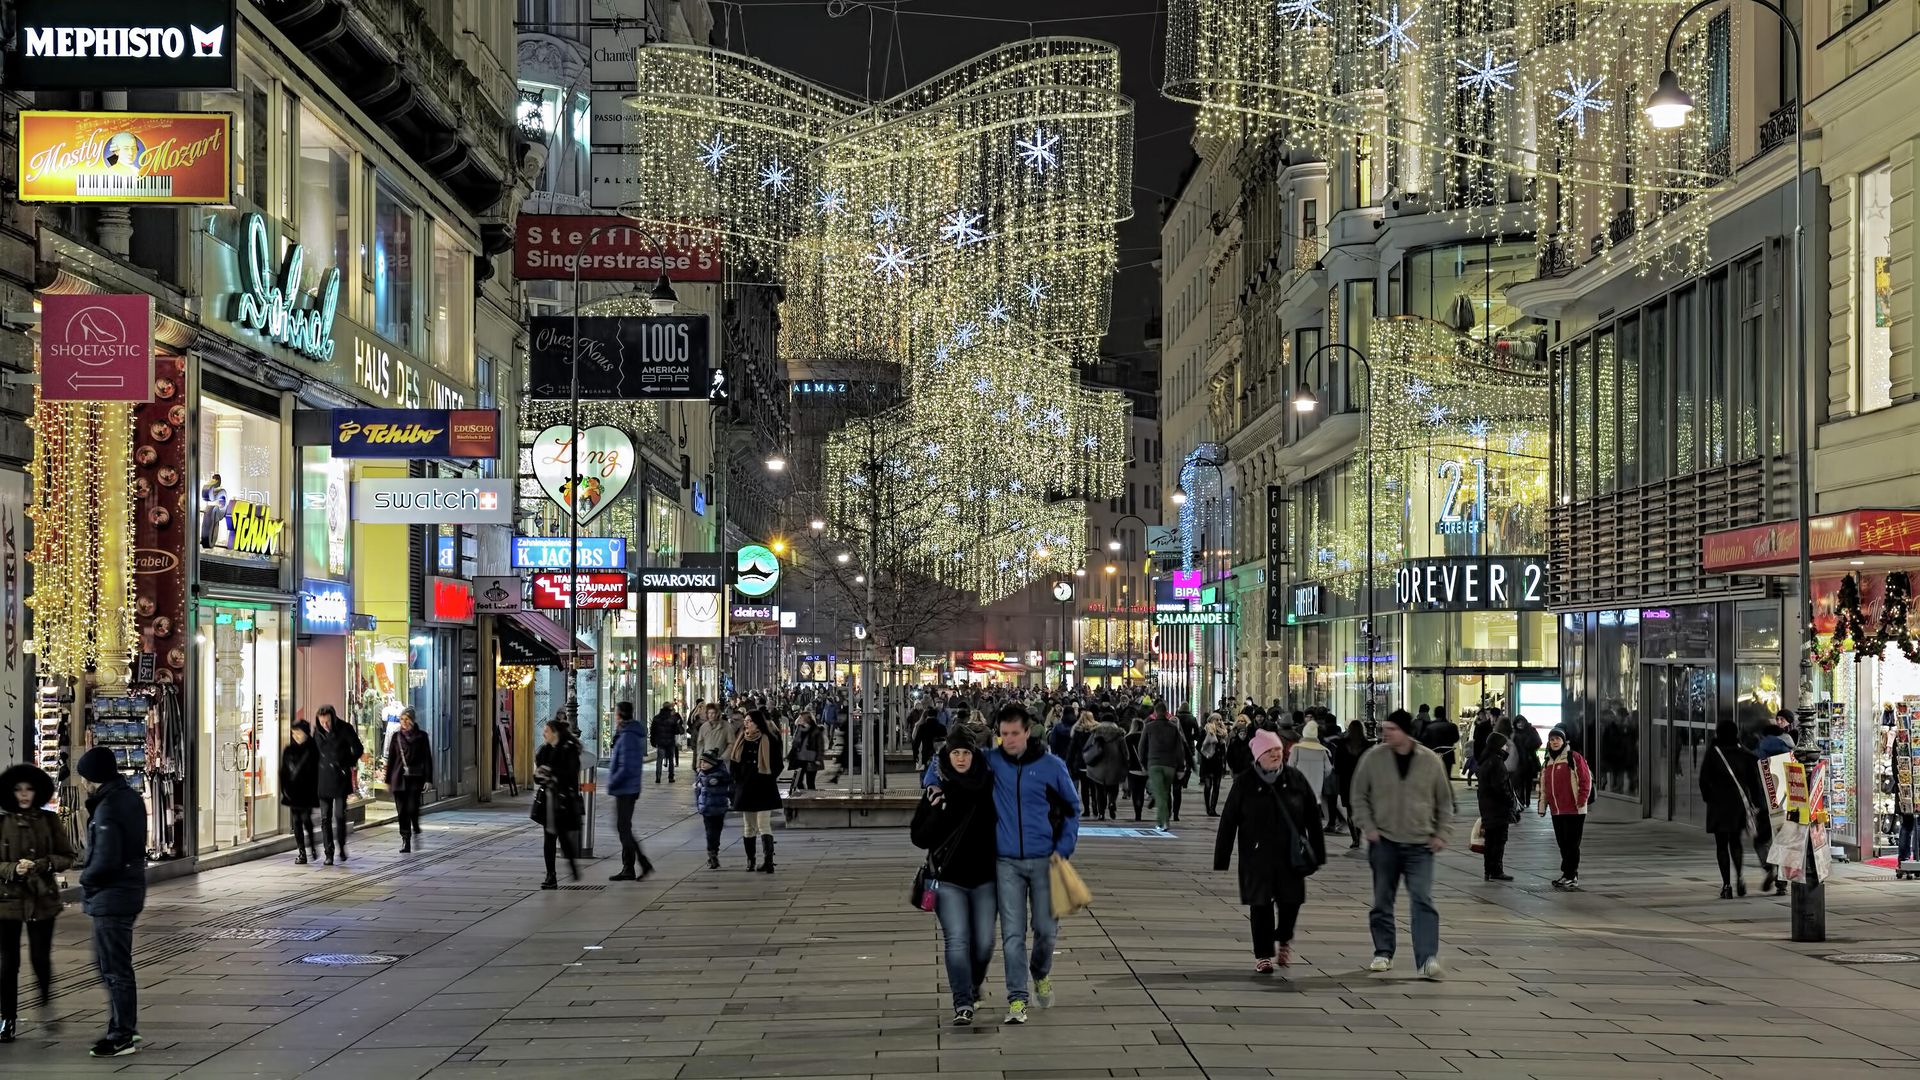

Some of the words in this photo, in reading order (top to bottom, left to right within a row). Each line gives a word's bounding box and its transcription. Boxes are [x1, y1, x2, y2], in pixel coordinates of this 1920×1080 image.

[24, 27, 185, 58] MEPHISTO
[594, 48, 638, 62] Chantell
[594, 114, 642, 122] PASSIONATA
[26, 128, 103, 182] Mostly
[138, 128, 222, 180] Mozart
[527, 226, 630, 245] Steffl
[527, 250, 690, 271] Singerstrasse
[698, 253, 712, 270] 5
[51, 344, 141, 357] SHOETASTIC
[536, 328, 573, 351] Chez
[563, 338, 614, 371] Nous
[641, 323, 689, 362] LOOS
[355, 336, 390, 399] HAUS
[397, 360, 420, 409] DES
[641, 366, 690, 374] AMERICAN
[641, 374, 690, 383] BAR
[793, 383, 846, 392] ALMAZ
[362, 424, 444, 443] Tchibo
[454, 424, 494, 433] EDUSCHO
[542, 431, 622, 478] Lnz
[374, 488, 479, 510] swatch
[1437, 457, 1488, 522] 21
[231, 500, 284, 555] Tchibo
[1439, 521, 1480, 534] FOREVER
[517, 538, 583, 547] Zahnimplantoloie
[135, 555, 169, 567] rabell
[517, 548, 535, 567] K.
[554, 575, 590, 583] ITALAN
[642, 574, 716, 587] SWAROVSKI
[1396, 564, 1506, 605] FOREVER
[576, 592, 624, 609] Venezia
[1174, 587, 1201, 597] BIPA
[733, 608, 770, 618] claire's
[1156, 613, 1230, 624] SALAMANDER
[1271, 609, 1277, 635] 21
[4, 723, 16, 762] est
